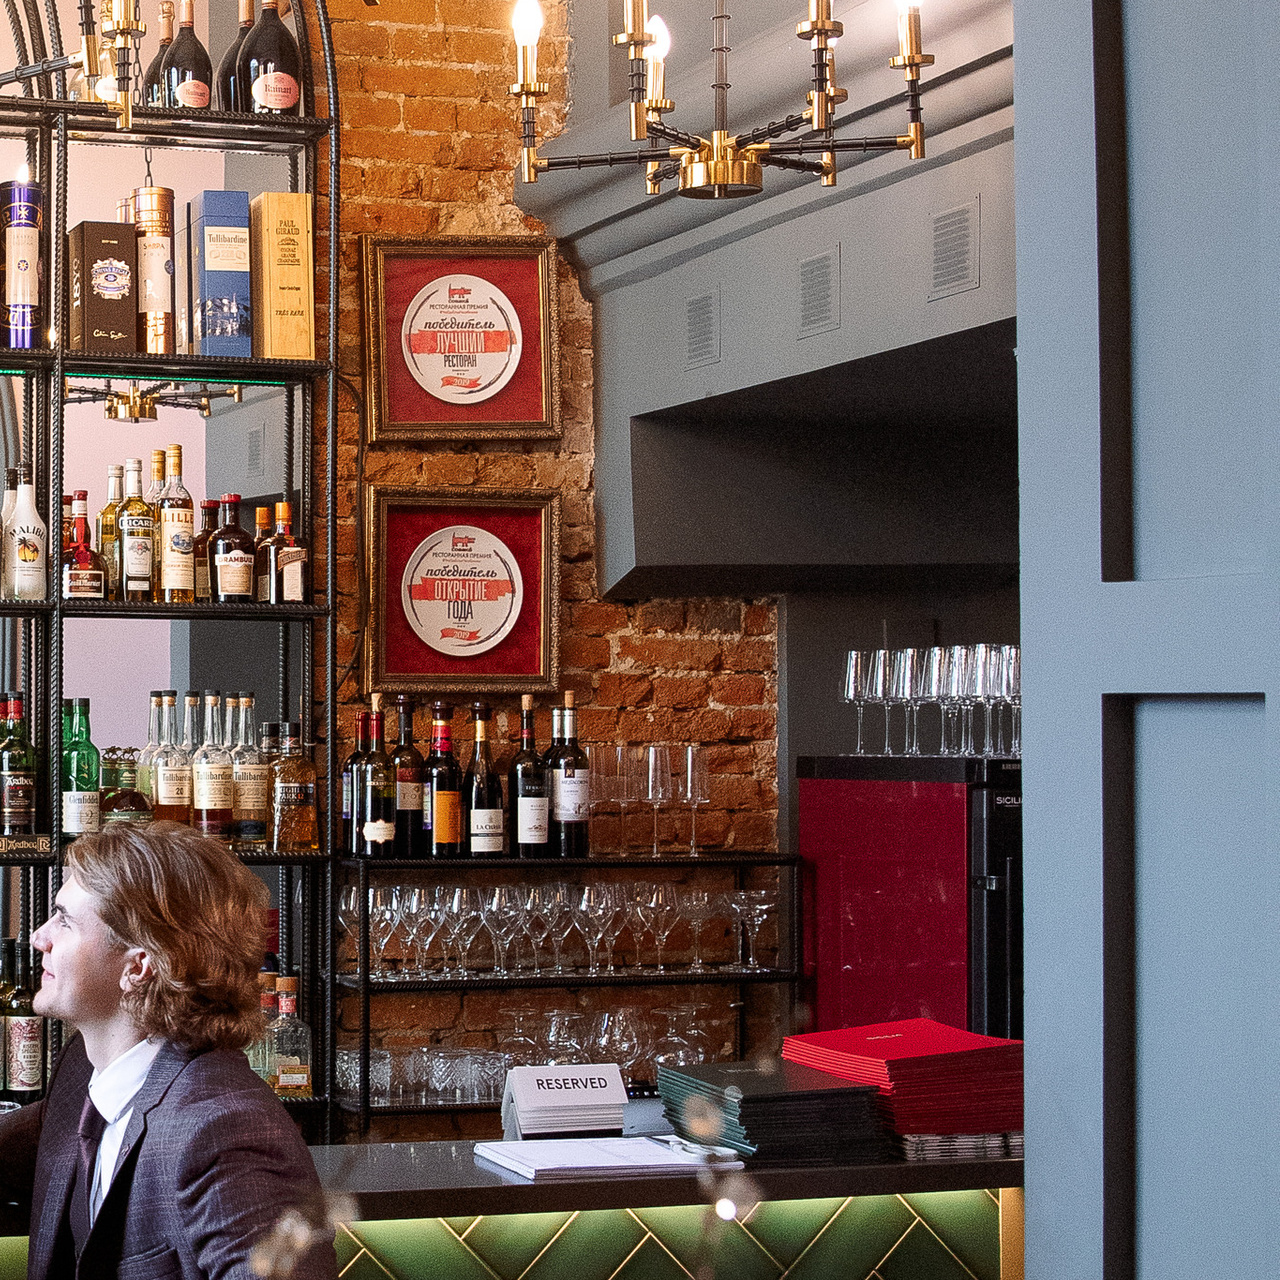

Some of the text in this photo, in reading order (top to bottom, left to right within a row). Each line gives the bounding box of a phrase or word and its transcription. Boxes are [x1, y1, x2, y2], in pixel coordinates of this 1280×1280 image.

[279, 220, 296, 228] PAUL
[275, 227, 300, 236] GIRAUD
[207, 233, 248, 244] Tullibardine
[424, 317, 496, 329] победитель
[443, 354, 477, 367] РЕСТОРАН
[9, 525, 46, 541] MALIBU
[425, 565, 498, 577] победитель
[434, 580, 488, 600] ОТКРЫТИЕ
[447, 600, 474, 621] ГОДА
[6, 775, 34, 786] Ardbeg
[175, 787, 184, 795] 20
[7, 839, 38, 850] Ardbeg
[535, 1076, 608, 1091] RESERVED
